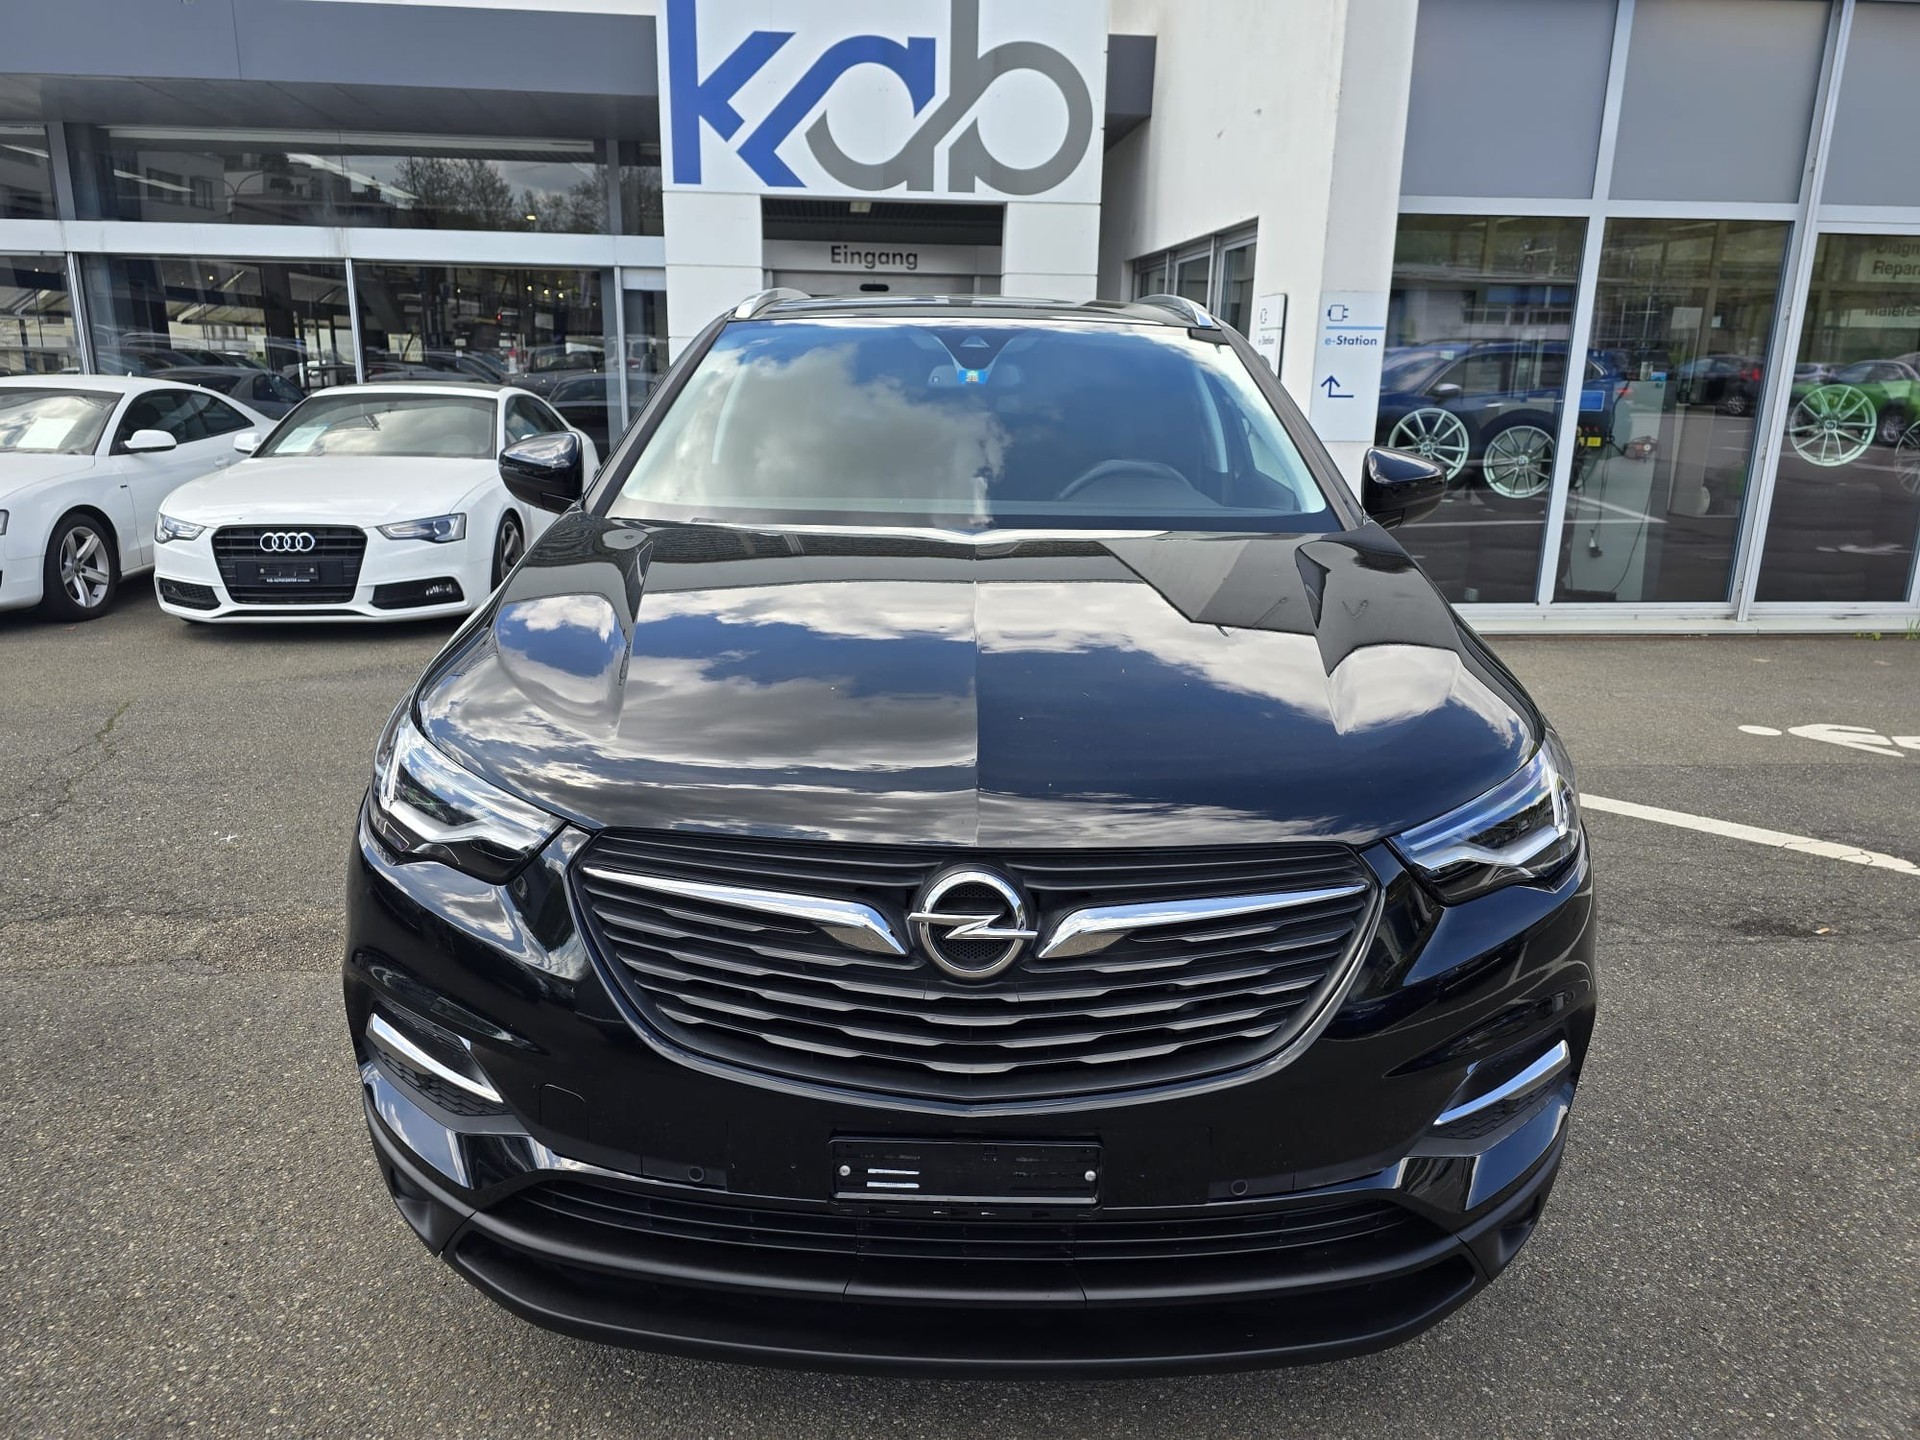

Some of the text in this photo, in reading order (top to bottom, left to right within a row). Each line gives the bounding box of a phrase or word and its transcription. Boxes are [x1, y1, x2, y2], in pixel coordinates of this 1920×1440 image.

[831, 245, 918, 270] Eingang
[1873, 260, 1920, 279] Repar
[1324, 335, 1377, 346] e-Station
